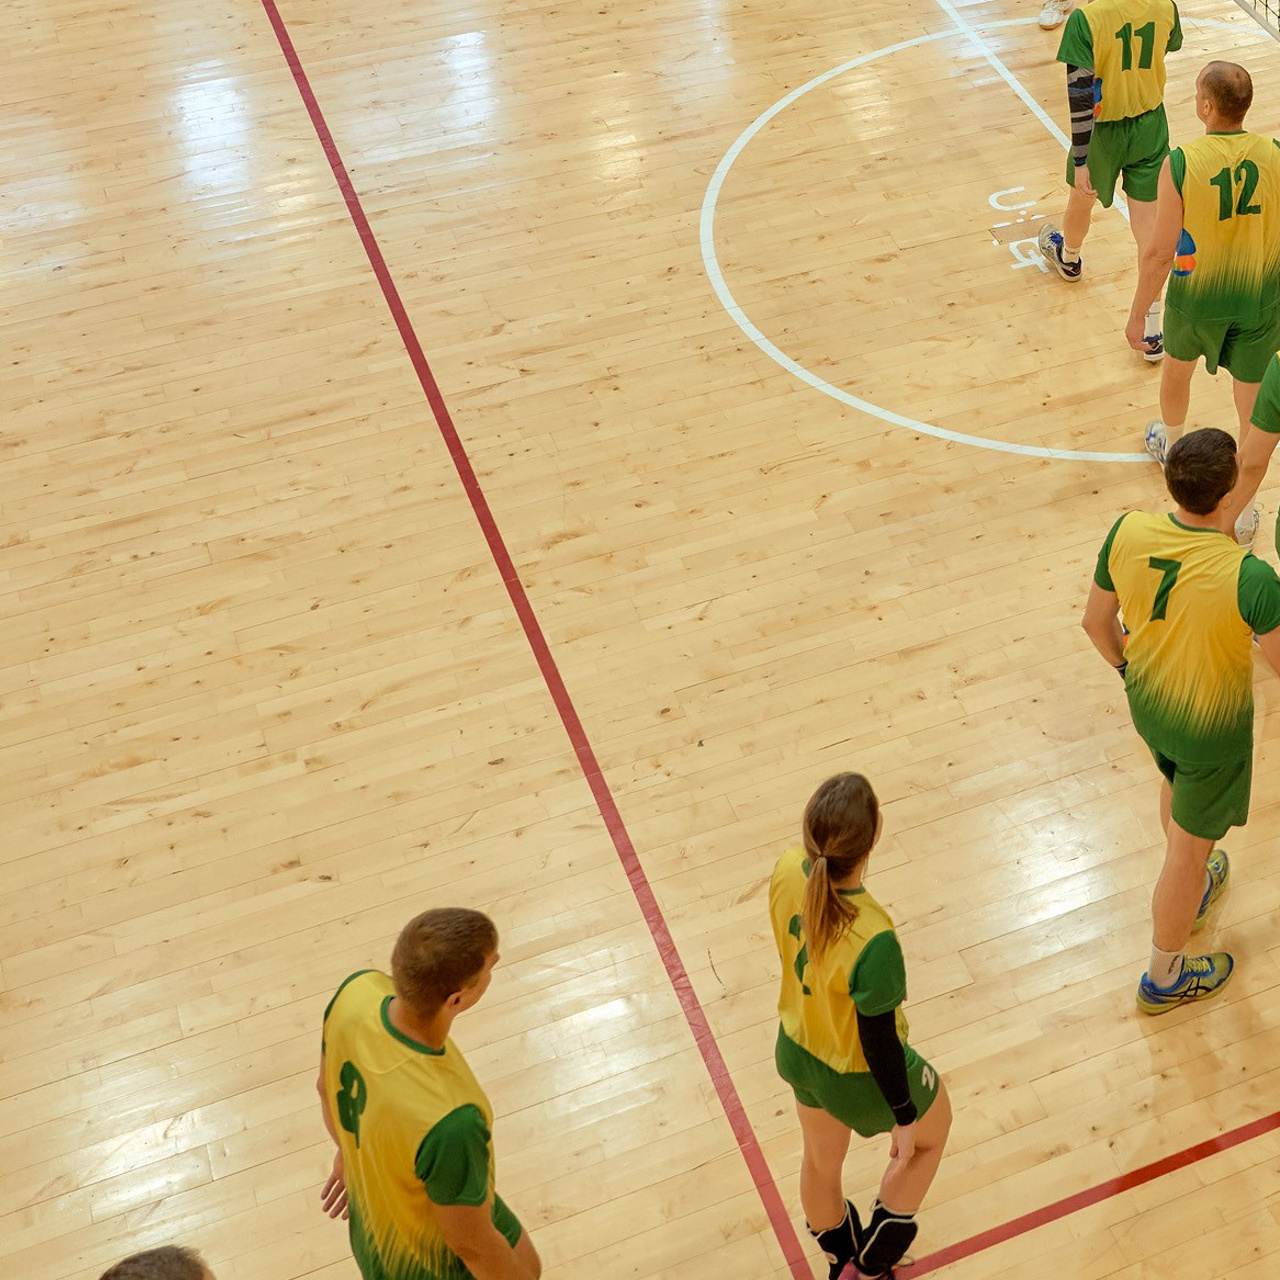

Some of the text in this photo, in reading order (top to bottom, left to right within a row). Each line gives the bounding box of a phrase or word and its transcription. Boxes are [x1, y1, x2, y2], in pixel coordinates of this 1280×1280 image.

[1115, 21, 1156, 72] 11
[1210, 159, 1262, 221] 12
[1148, 556, 1182, 622] 7
